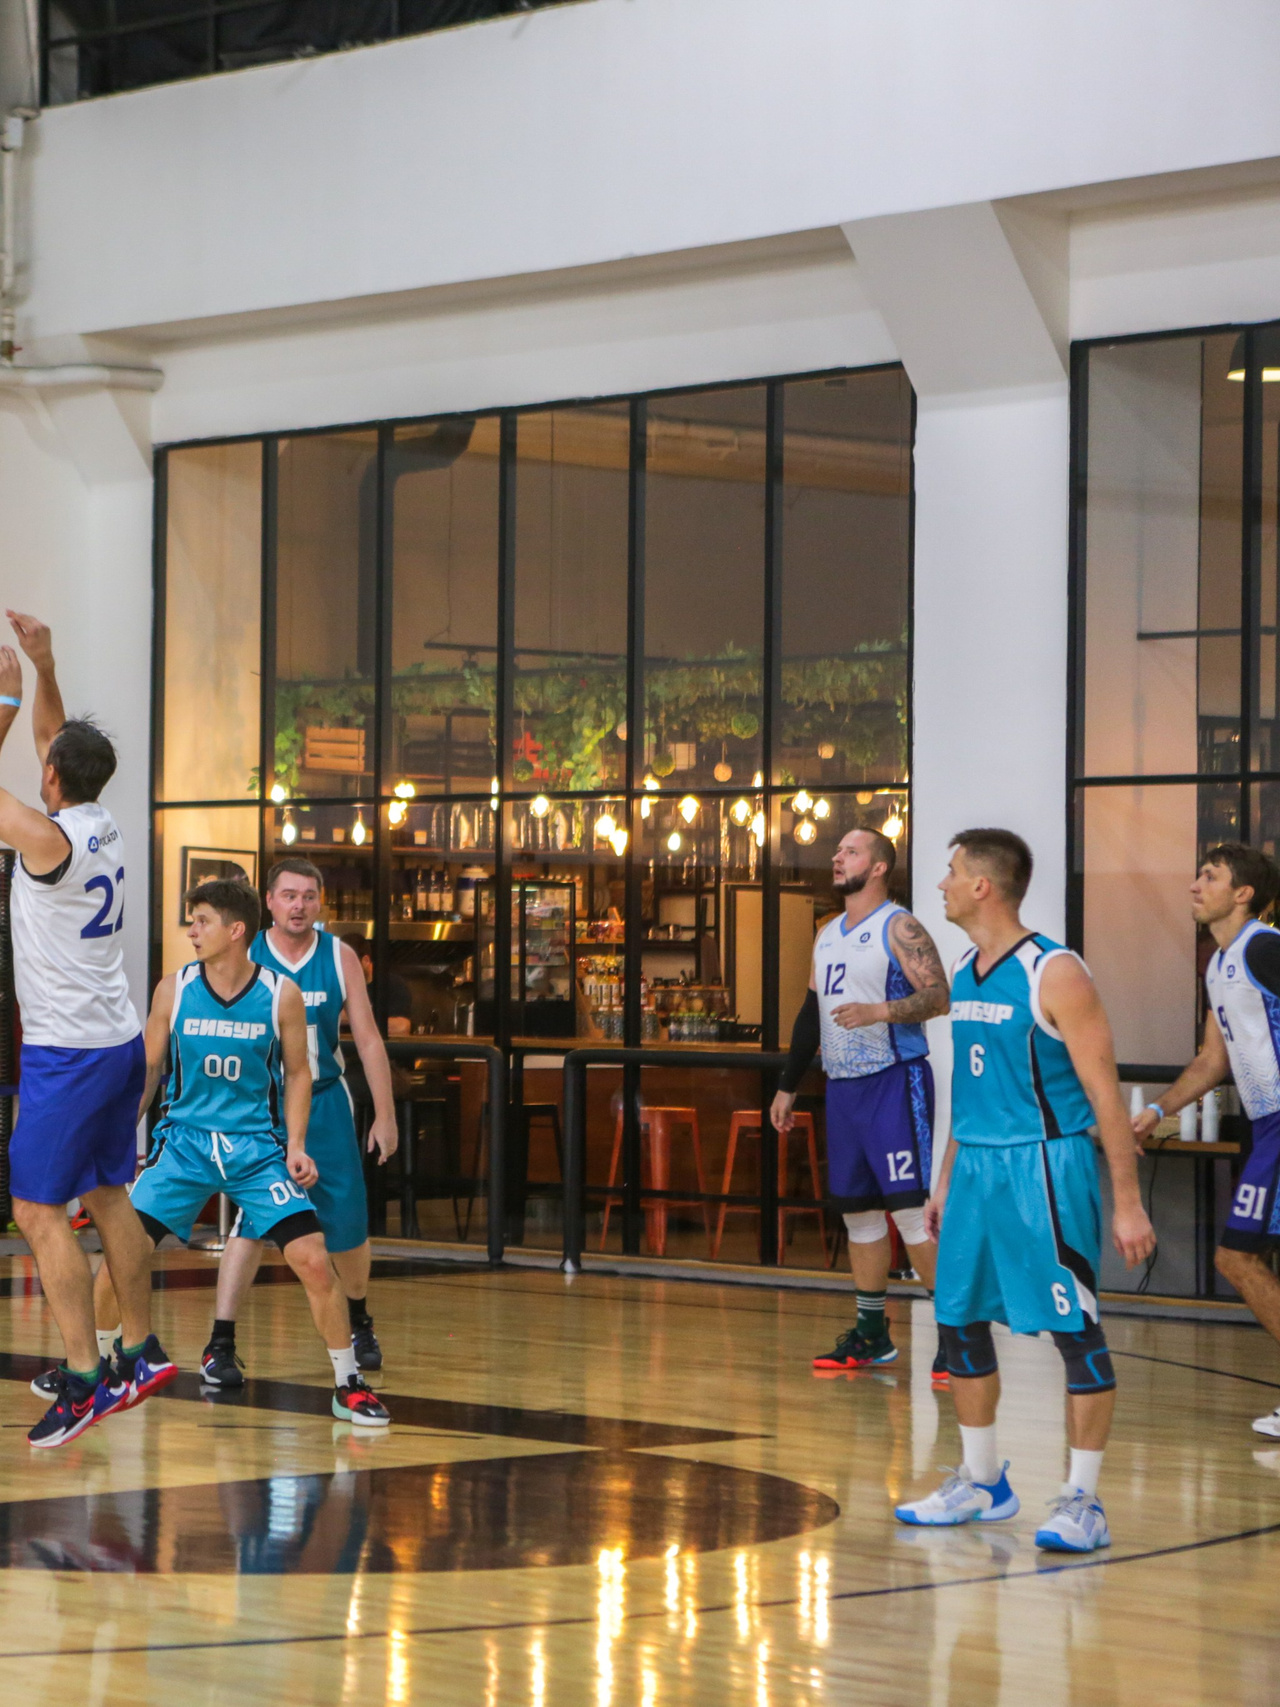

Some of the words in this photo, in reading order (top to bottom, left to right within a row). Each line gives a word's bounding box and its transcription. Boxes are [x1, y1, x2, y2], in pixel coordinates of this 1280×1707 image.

[824, 963, 846, 996] 12
[951, 1000, 1014, 1025] СИБУР
[183, 1018, 266, 1040] СИБУР
[204, 1054, 242, 1082] 00
[970, 1043, 986, 1077] 6
[886, 1150, 915, 1182] 12
[1233, 1183, 1267, 1221] 91
[1051, 1282, 1071, 1316] 6
